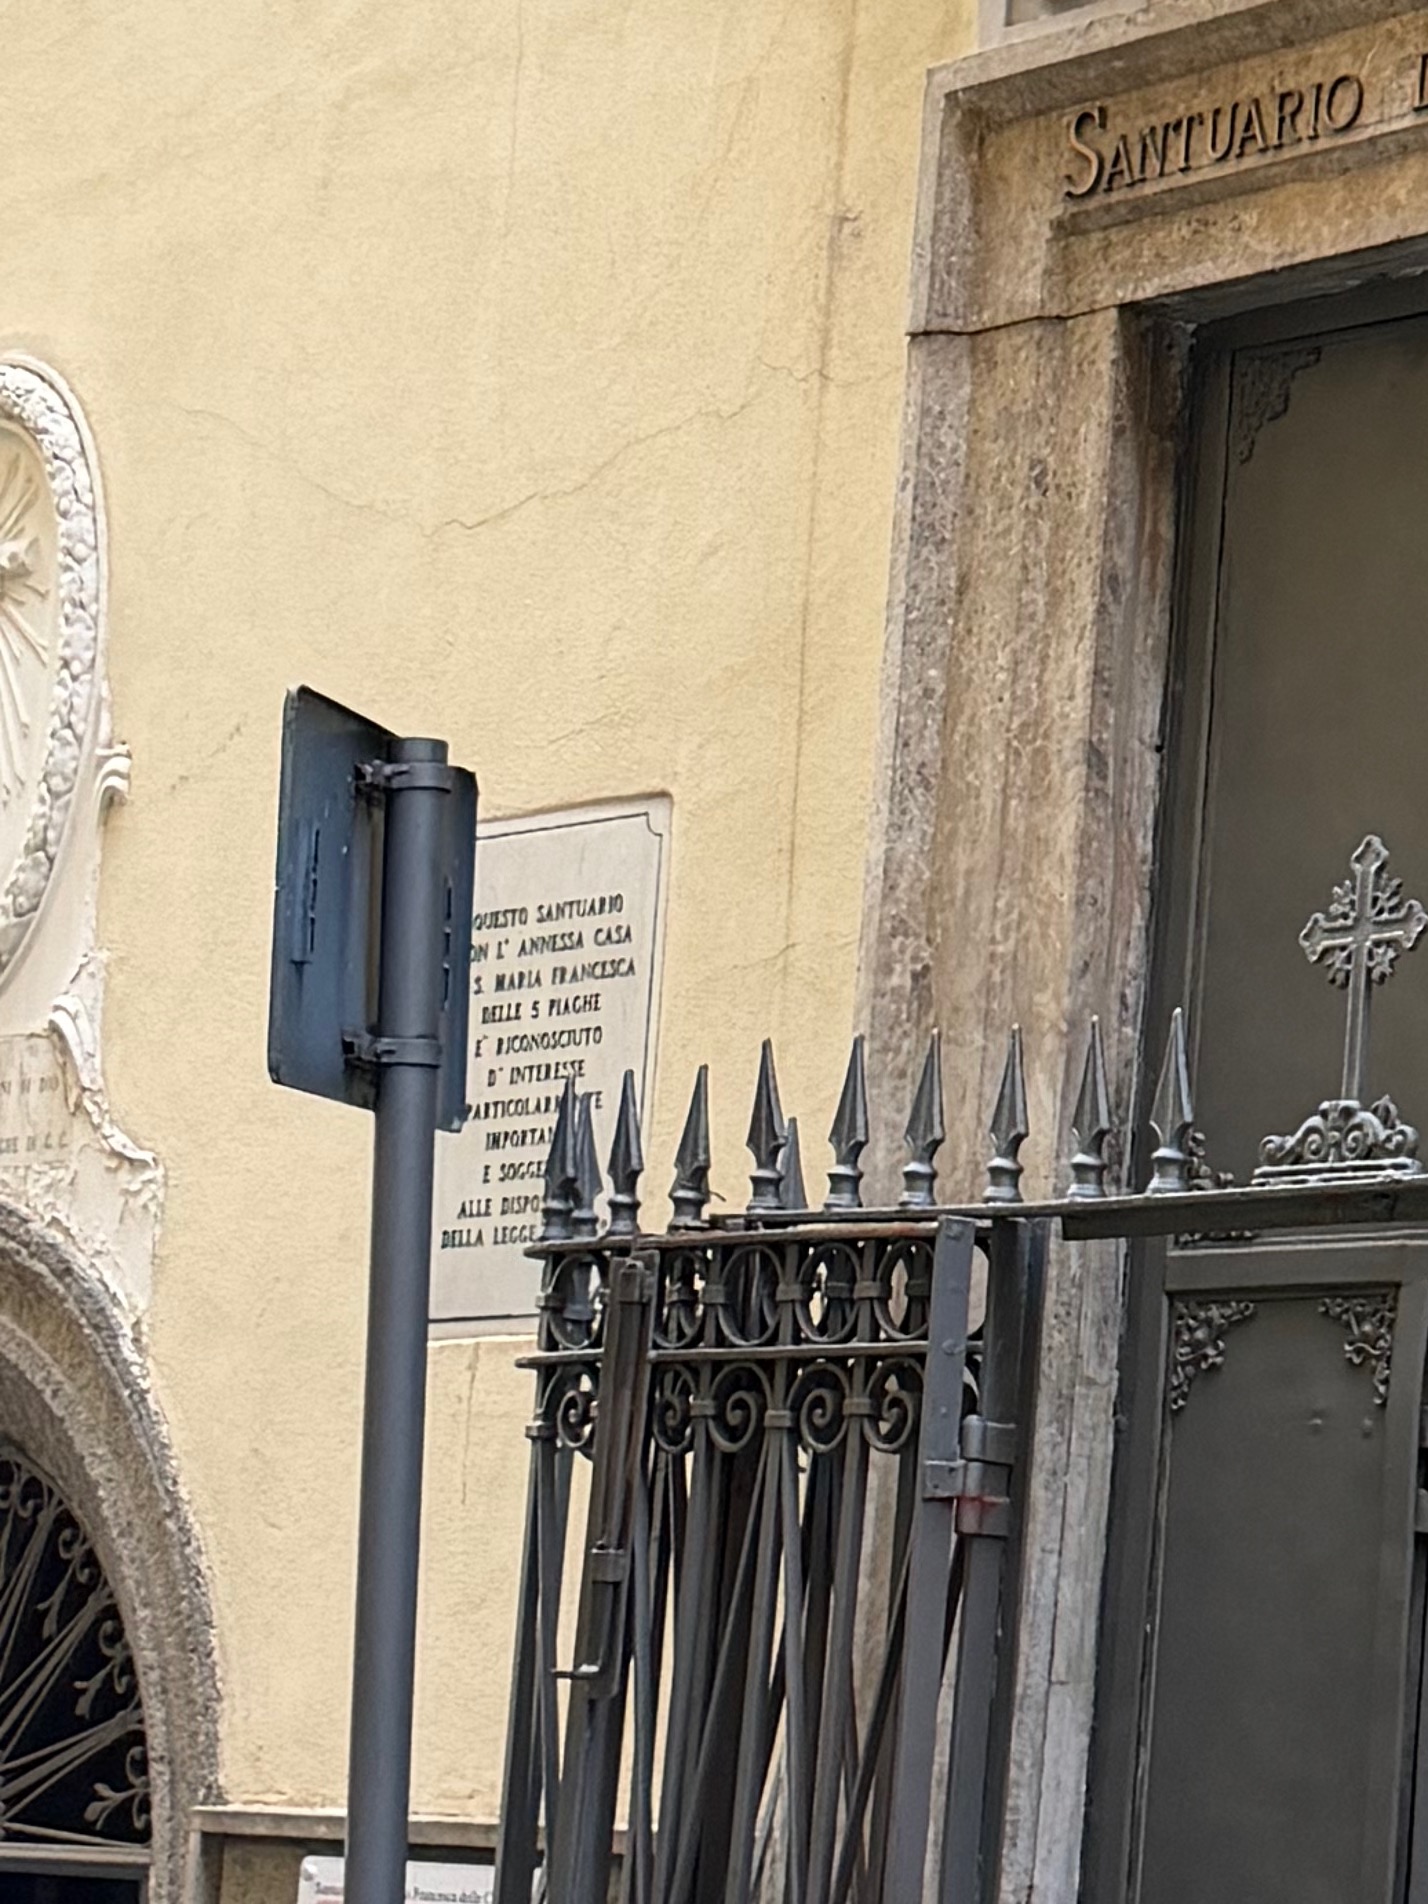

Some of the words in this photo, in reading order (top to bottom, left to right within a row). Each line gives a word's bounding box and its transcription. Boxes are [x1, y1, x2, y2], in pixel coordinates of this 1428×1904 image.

[1064, 74, 1364, 197] SANTUARIO
[475, 906, 529, 931] QUESTO
[536, 893, 625, 924] SANTUARIO
[470, 942, 489, 963] ON
[517, 930, 584, 958] ANNESSA
[593, 924, 633, 947] CASA
[494, 969, 542, 993] MARIA
[551, 957, 637, 986] FRANCESCA
[481, 1002, 522, 1024] DELLE
[531, 1000, 541, 1019] 5
[548, 992, 602, 1017] PIAGHE
[495, 1025, 603, 1056] RICONOSCIUTO
[509, 1059, 586, 1086] INTERESSE
[482, 1164, 491, 1184] E
[457, 1197, 493, 1220] ALLE
[440, 1227, 485, 1250] DELLA
[492, 1224, 537, 1245] LEGGE
